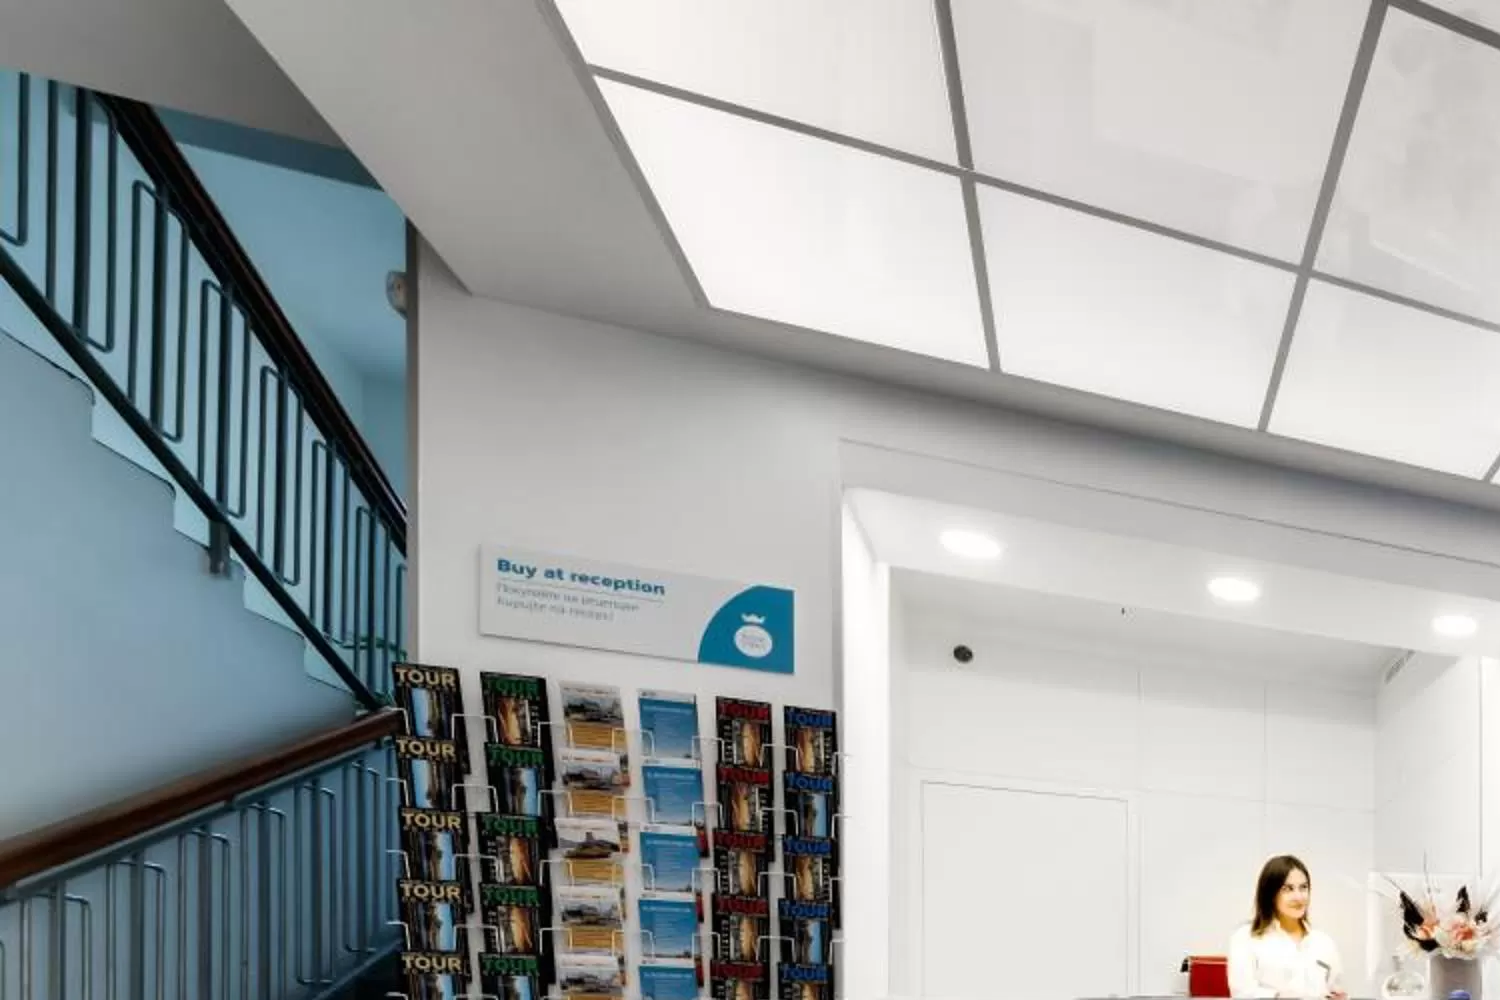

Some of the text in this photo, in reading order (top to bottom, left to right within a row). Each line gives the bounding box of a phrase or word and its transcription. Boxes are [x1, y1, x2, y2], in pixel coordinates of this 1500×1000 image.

[497, 559, 666, 596] Buy at reception
[396, 669, 456, 687] TOUR
[396, 739, 456, 757] TOUR
[402, 813, 462, 829] TOUR
[401, 884, 461, 900] TOUR
[402, 955, 462, 971] TOUR
